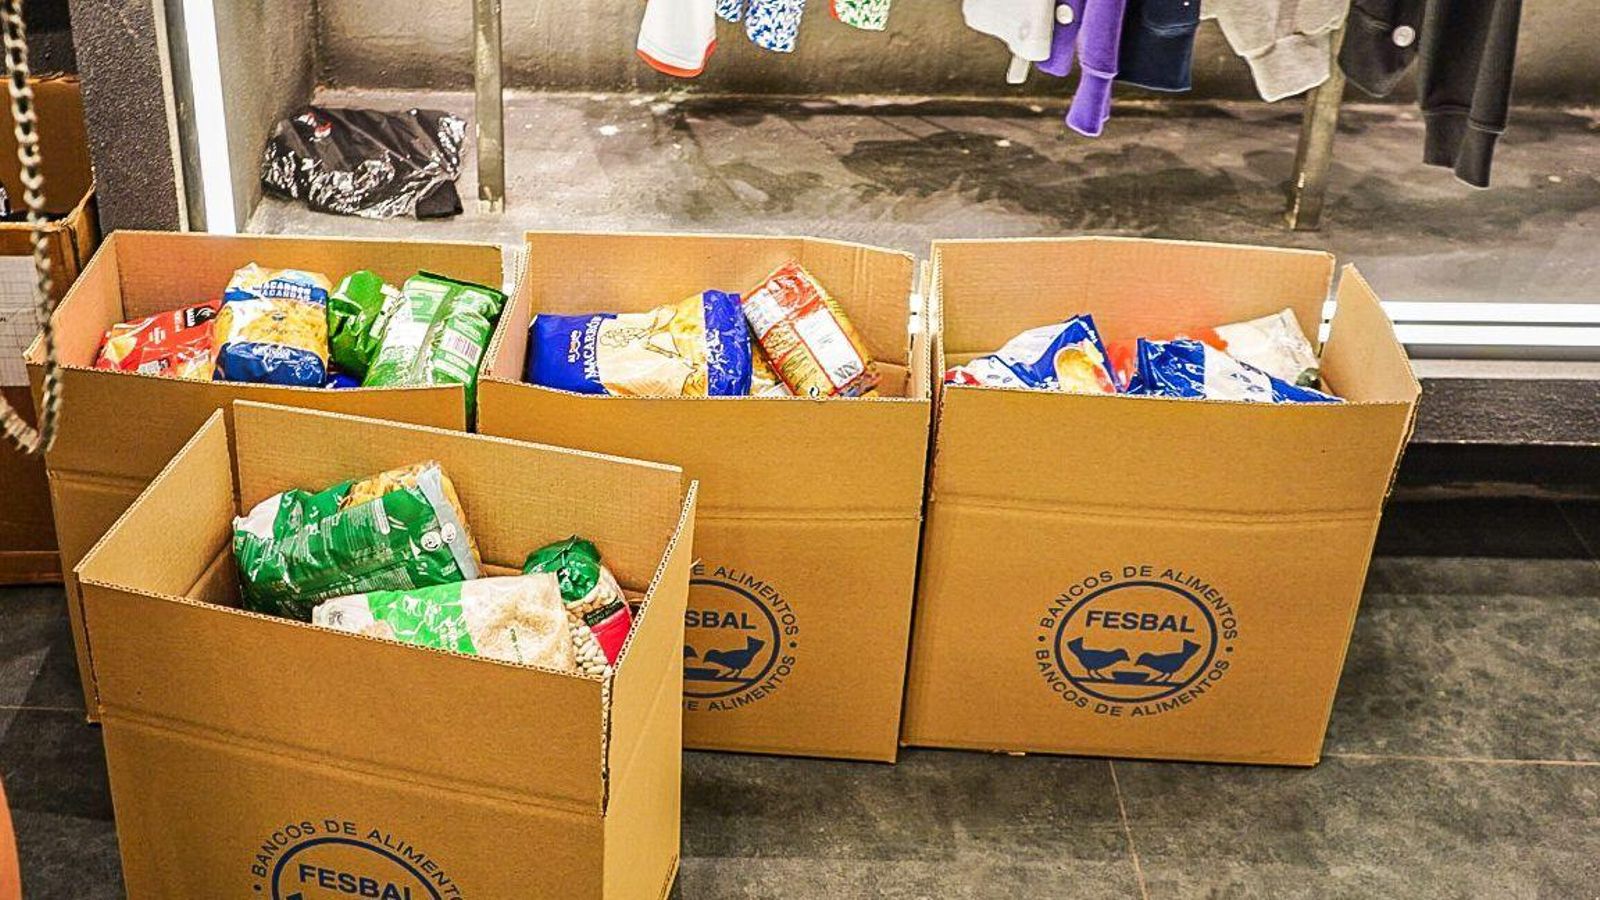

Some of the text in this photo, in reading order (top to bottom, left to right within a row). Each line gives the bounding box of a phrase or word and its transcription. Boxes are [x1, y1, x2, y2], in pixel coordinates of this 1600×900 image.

[685, 610, 757, 630] SBAL
[691, 563, 799, 636] E ALIMENTOS
[1039, 565, 1238, 640] BANCOS DE ALIMENTOS
[1085, 610, 1196, 633] FESBAL
[684, 655, 796, 712] E ALIMENTOS
[1035, 649, 1230, 717] BANCOS DE ALIMENTOS
[251, 820, 316, 878] BANCOS
[325, 819, 358, 836] DE
